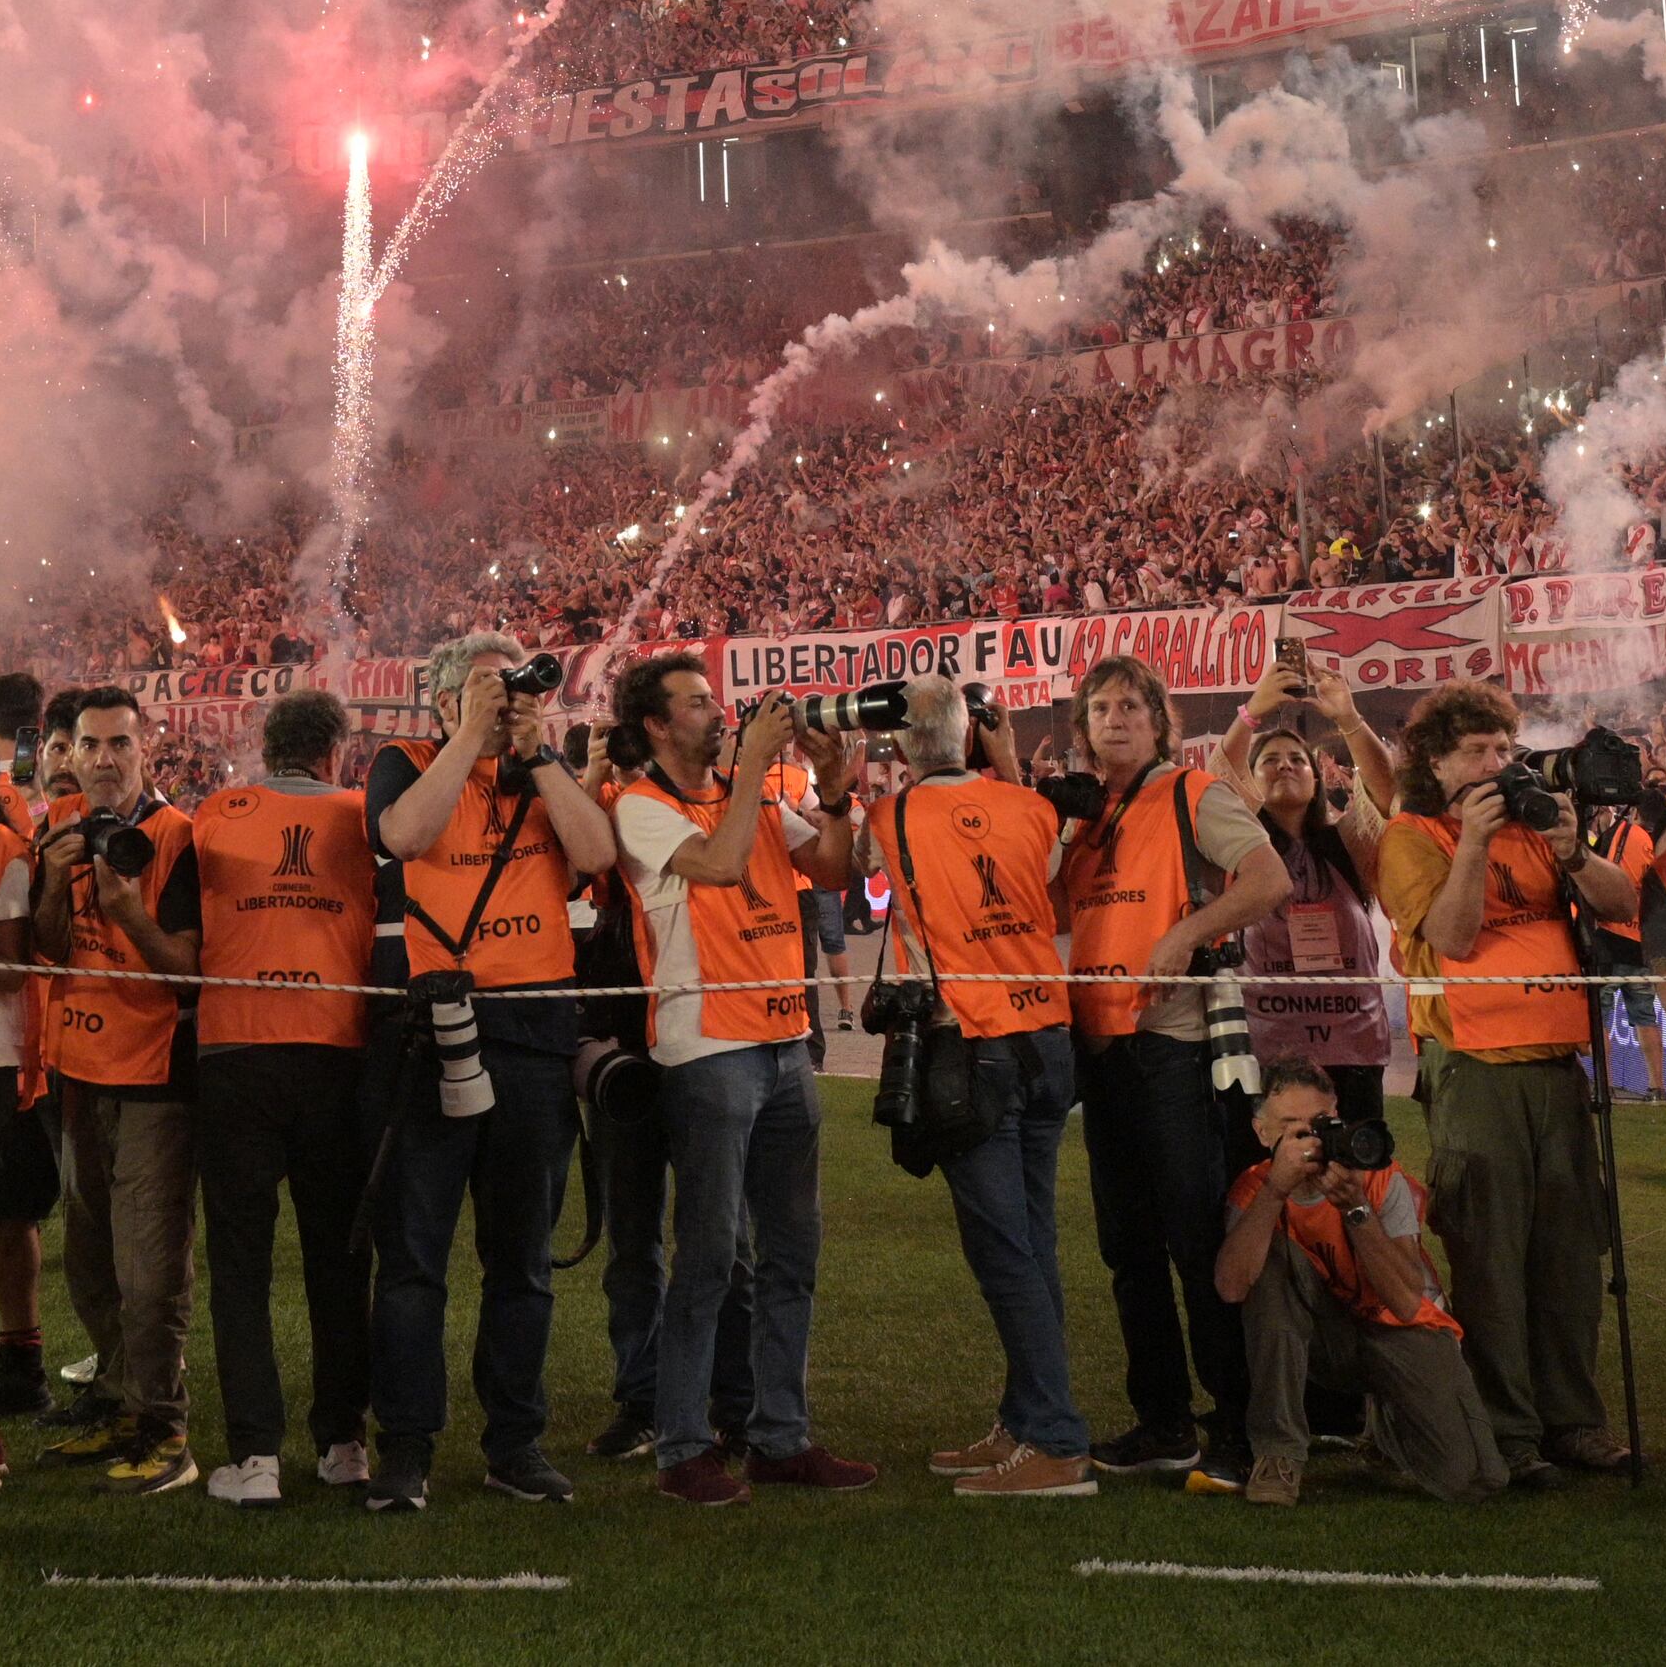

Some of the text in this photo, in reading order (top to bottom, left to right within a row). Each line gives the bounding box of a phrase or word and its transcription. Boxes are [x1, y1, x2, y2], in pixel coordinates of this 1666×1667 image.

[1093, 320, 1358, 384] ALMAGRO
[1287, 574, 1505, 609] MARCELO
[731, 622, 1063, 688] LIBERTADOR FAU
[1068, 609, 1265, 695] 42 CABALLITO
[1327, 647, 1493, 684] ORES
[129, 664, 295, 702] PACHECO
[228, 797, 248, 809] 56
[962, 816, 981, 828] 06
[450, 841, 550, 867] LIBERORES
[236, 895, 345, 914] LIBERTADORES
[478, 914, 541, 941] FOTO
[1264, 957, 1356, 972] LIBEES
[1257, 994, 1368, 1014] CONMEBOL
[62, 1007, 104, 1034] OTO
[1305, 1025, 1332, 1043] TV
